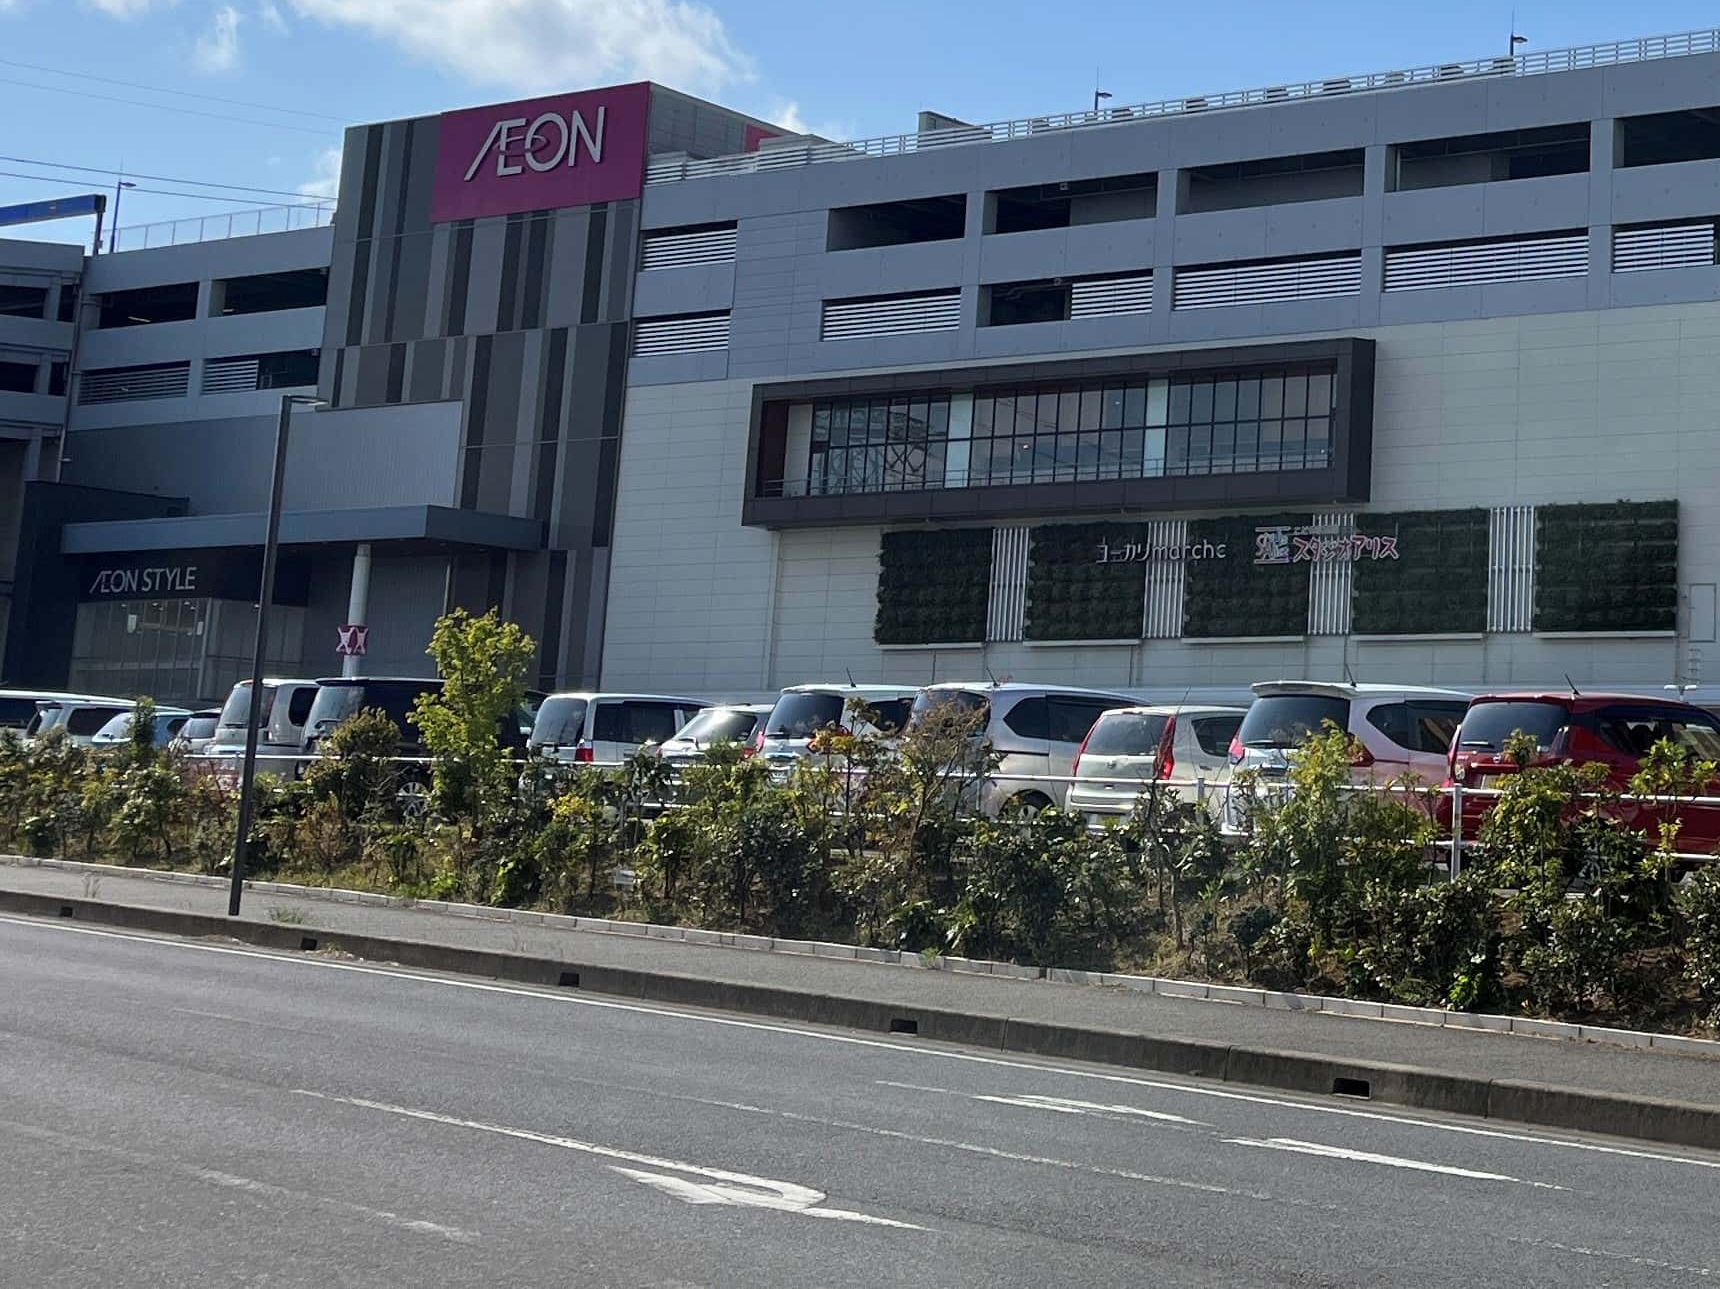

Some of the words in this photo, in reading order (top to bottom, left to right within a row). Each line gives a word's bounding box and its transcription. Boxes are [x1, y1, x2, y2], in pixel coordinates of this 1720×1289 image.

[1292, 534, 1399, 562] スタジオアリス
[141, 567, 197, 591] STYLE
